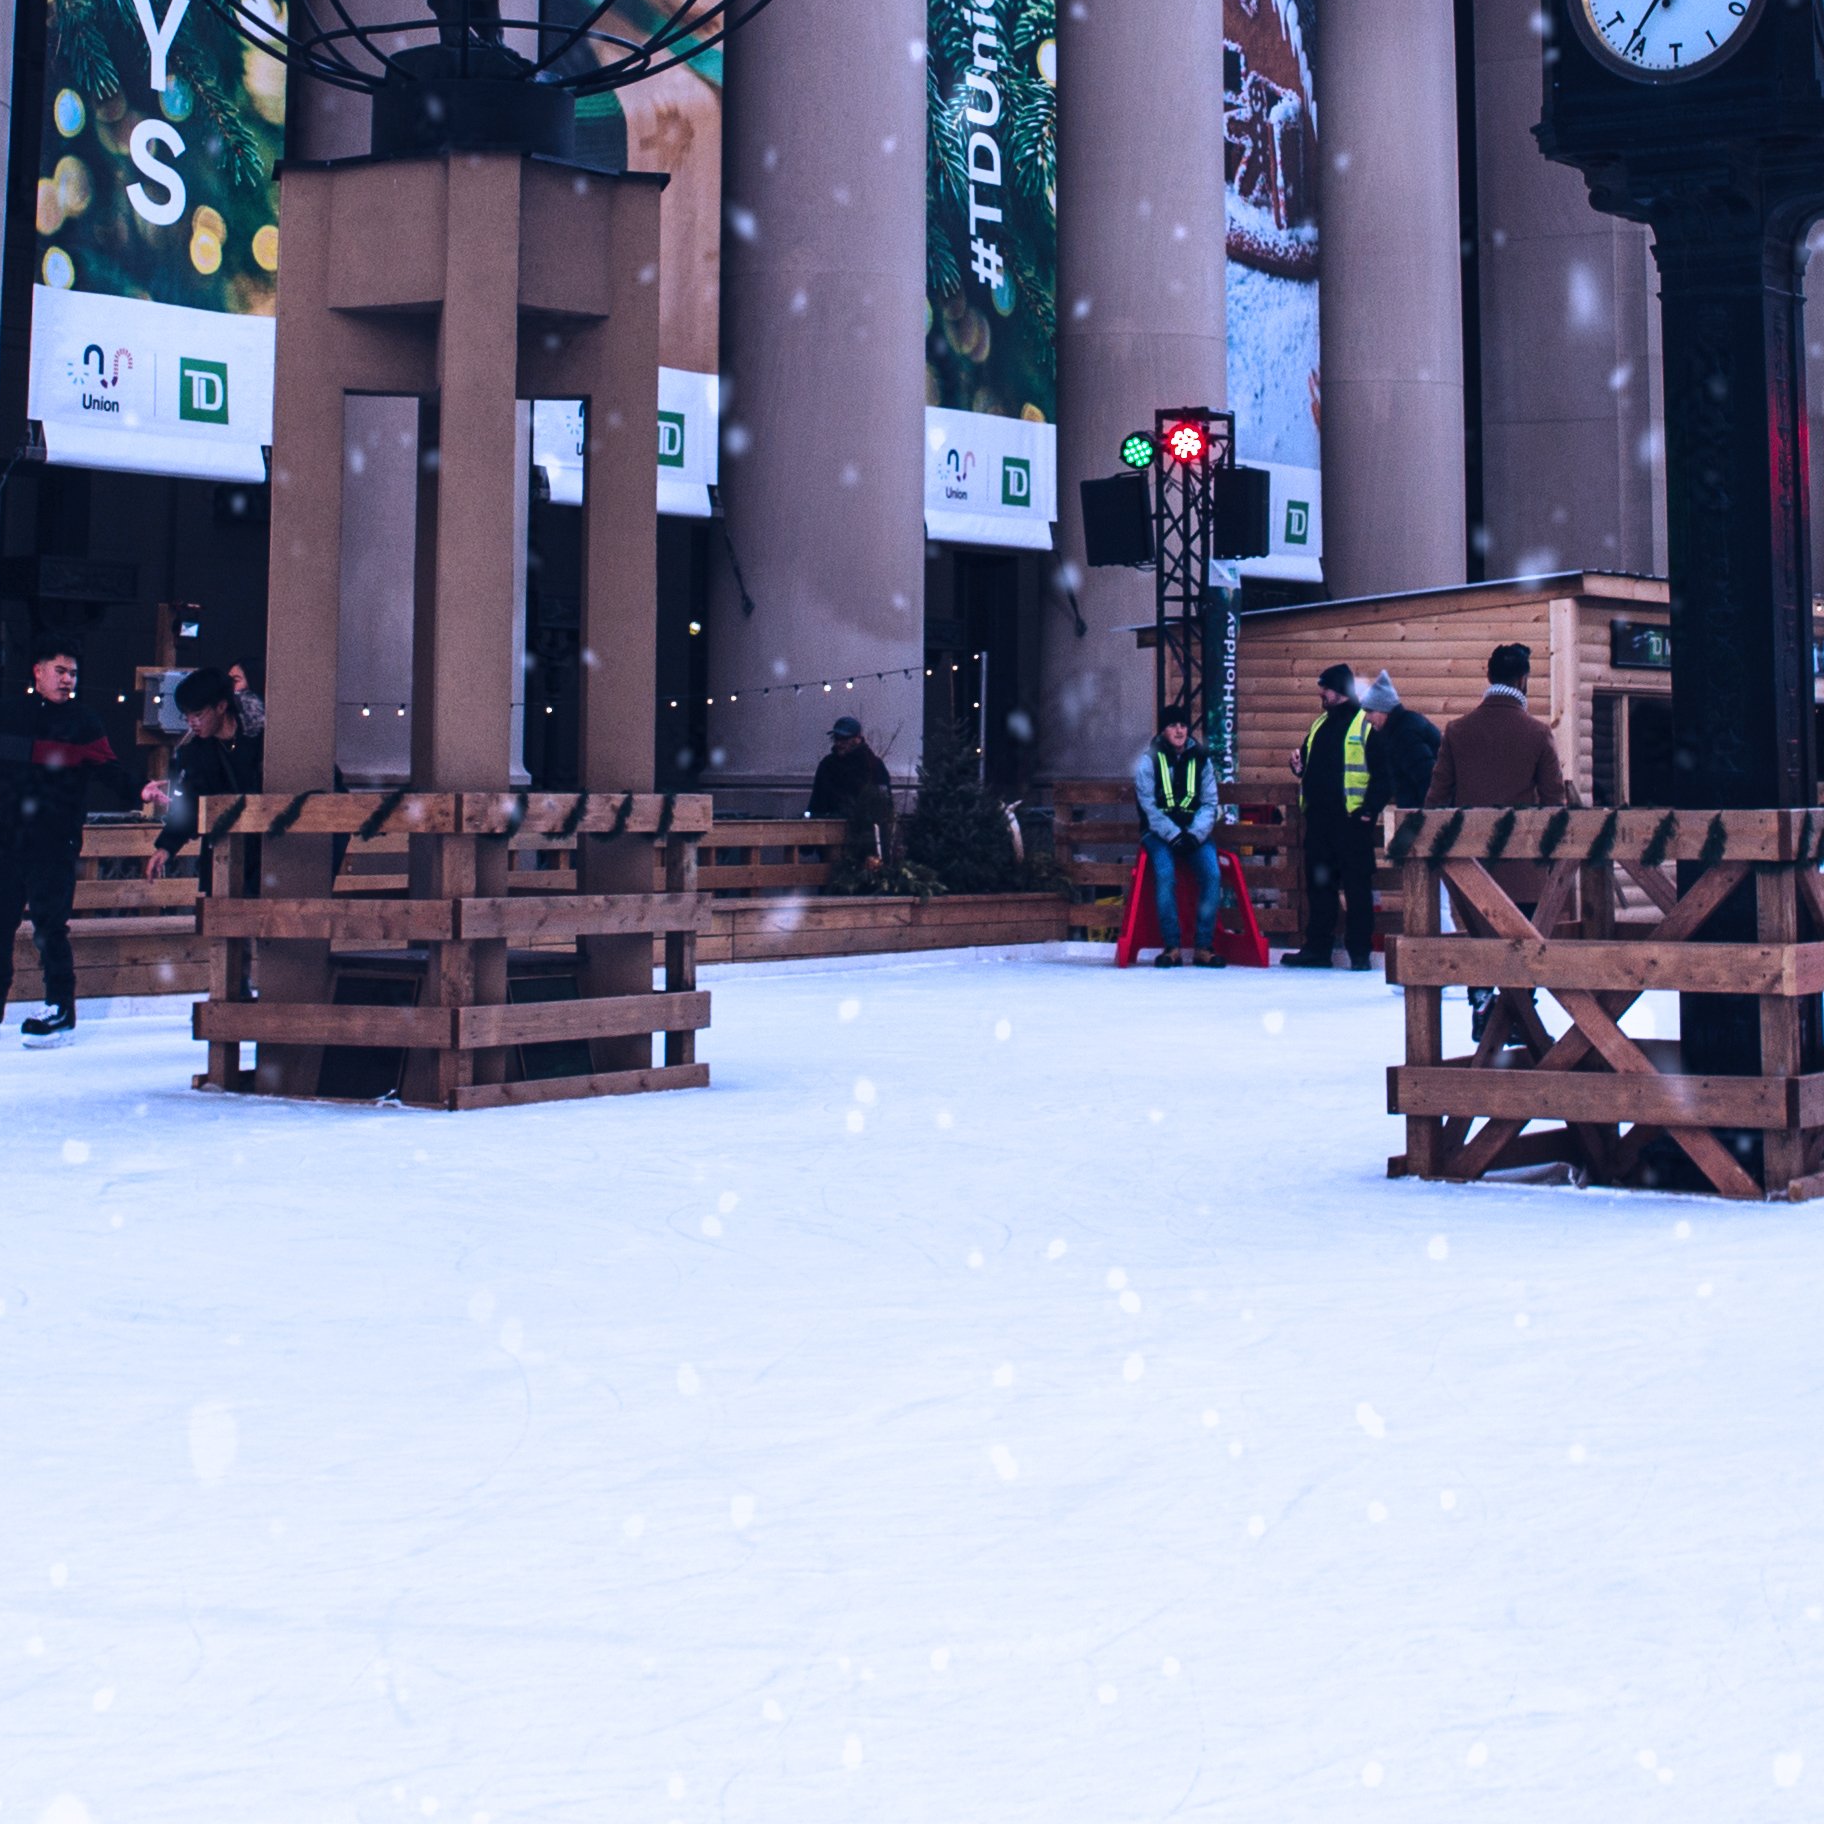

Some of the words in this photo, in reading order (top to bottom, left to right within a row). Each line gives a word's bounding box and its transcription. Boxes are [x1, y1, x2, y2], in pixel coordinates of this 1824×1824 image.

[81, 392, 120, 413] Union
[184, 368, 225, 412] TD
[945, 486, 968, 501] Union
[1005, 465, 1028, 497] TD
[1289, 508, 1307, 536] TD
